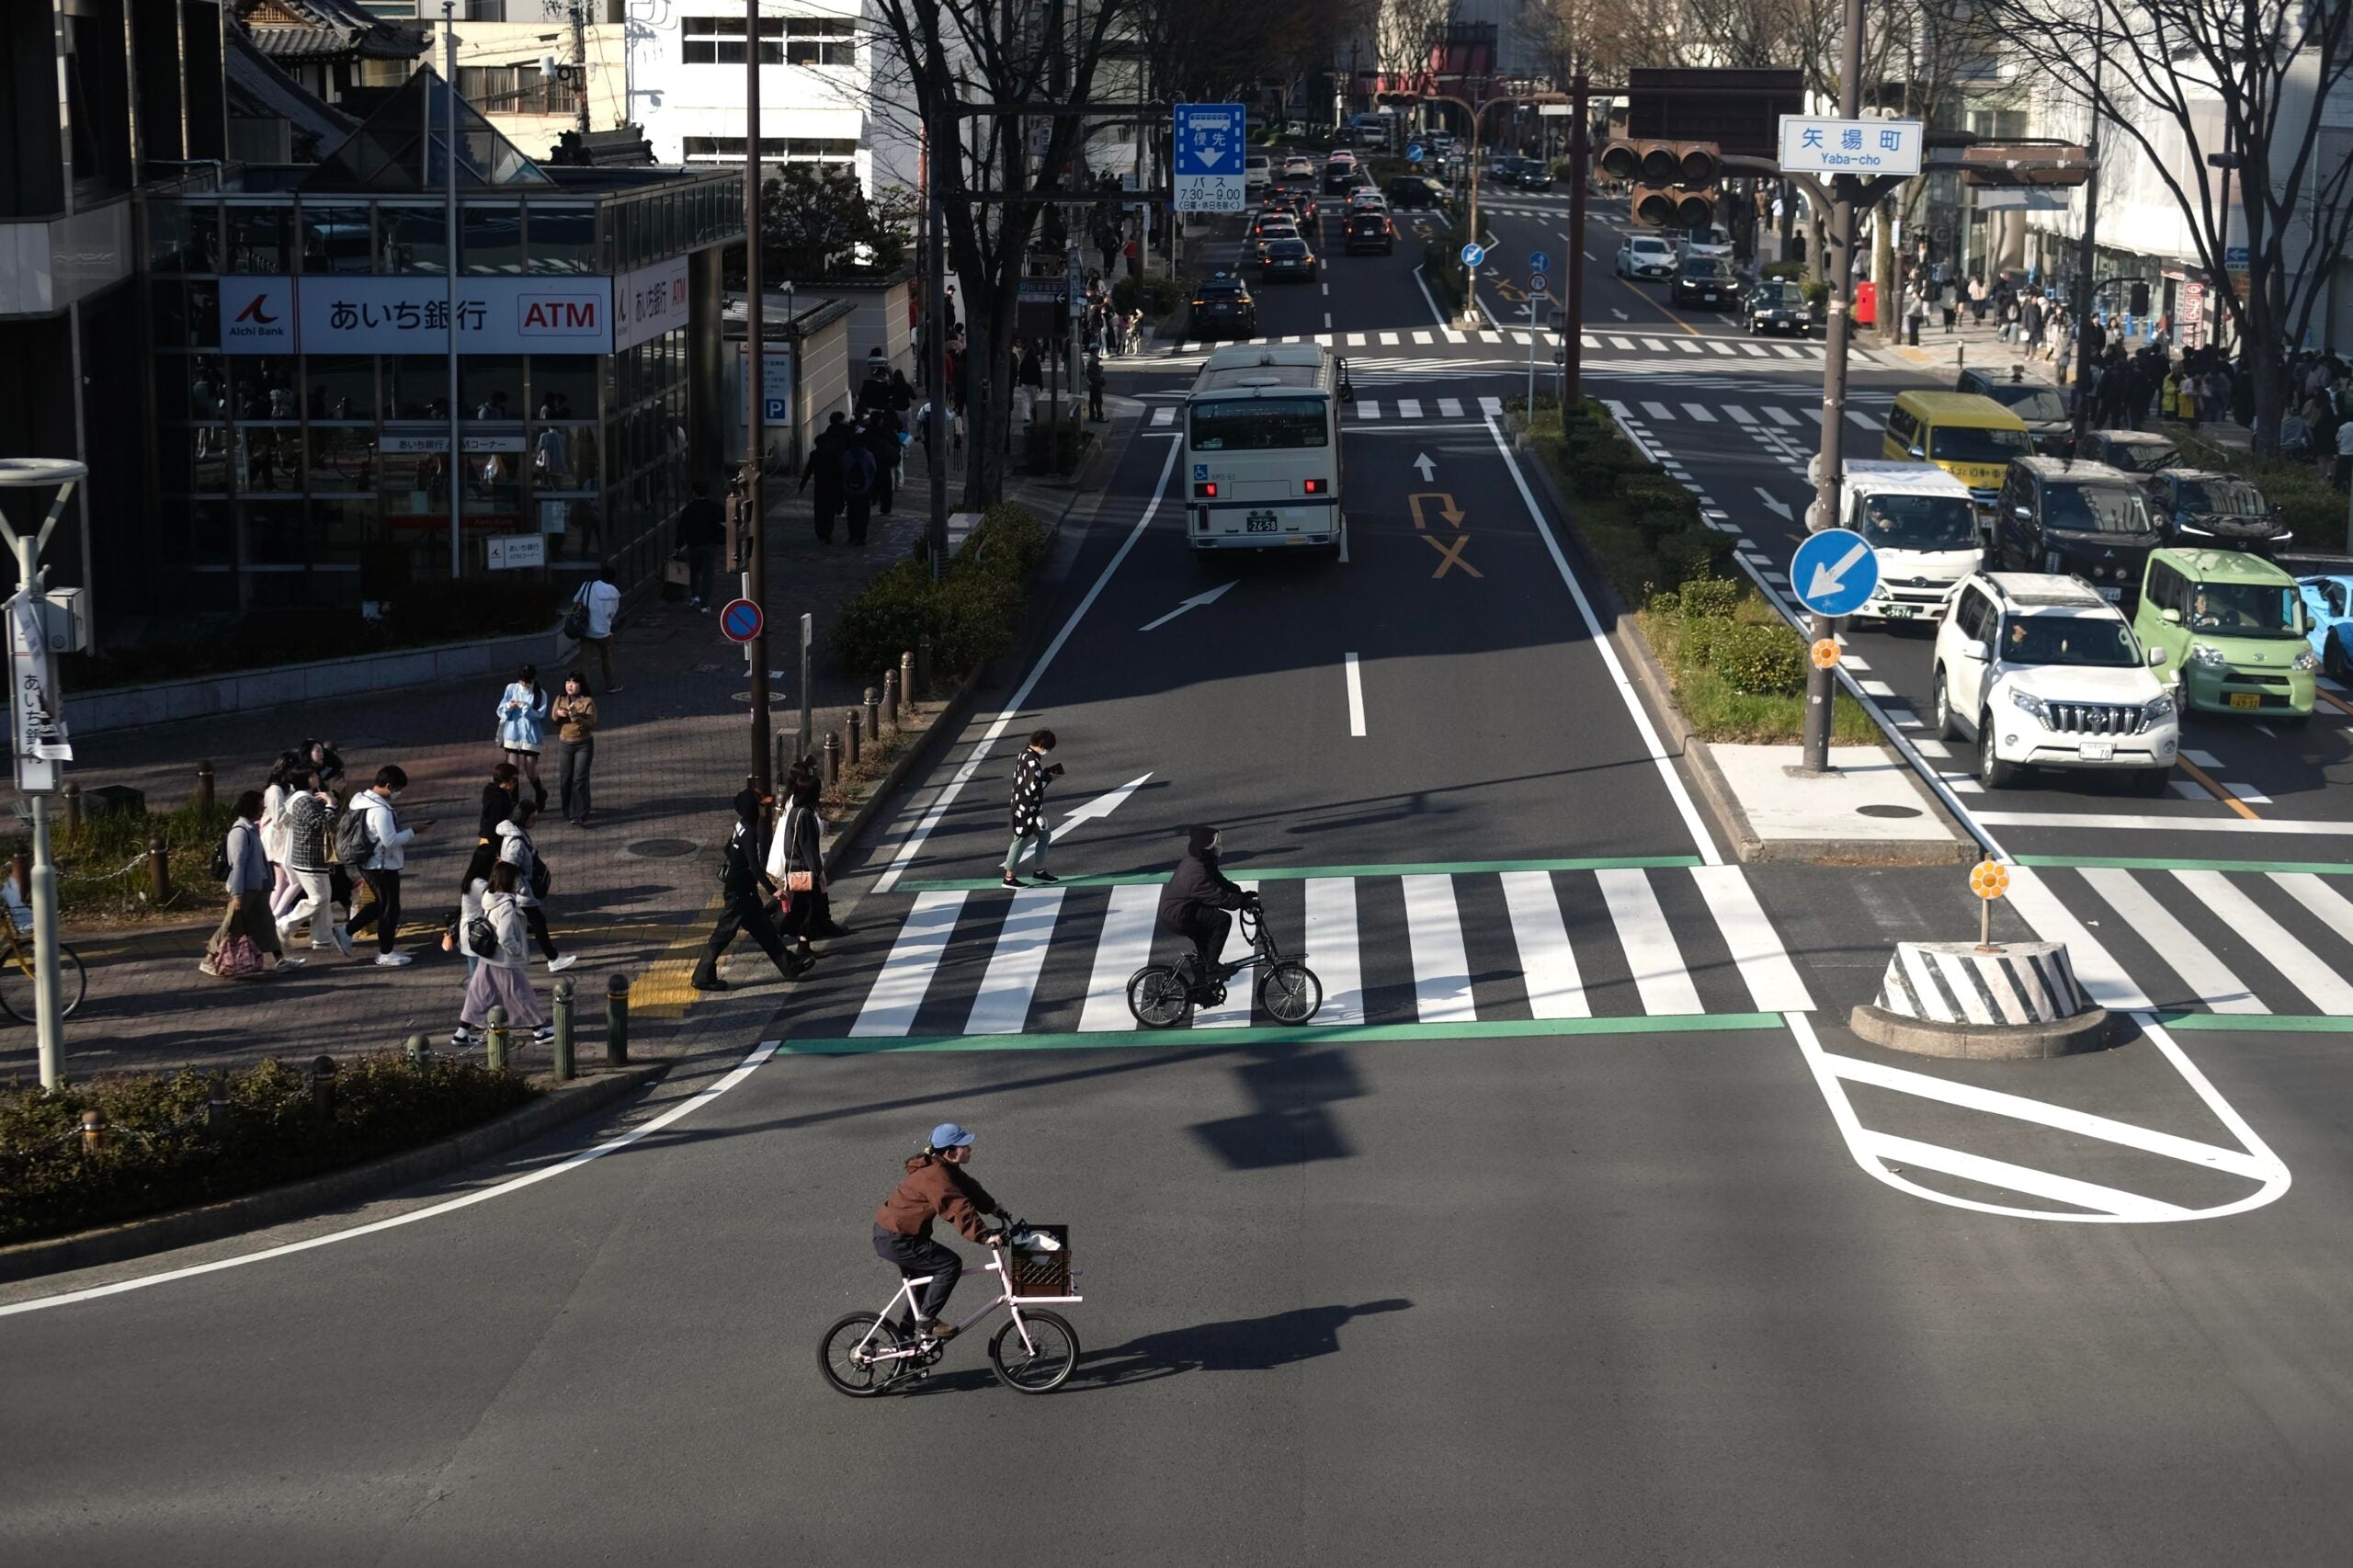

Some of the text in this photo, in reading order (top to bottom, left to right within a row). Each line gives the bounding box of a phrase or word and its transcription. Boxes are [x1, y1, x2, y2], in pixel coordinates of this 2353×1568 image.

[1194, 131, 1226, 146] 優先
[1802, 128, 1901, 151] 矢場町
[1821, 153, 1881, 165] Yaba-cho
[1194, 177, 1225, 187] バス
[635, 281, 667, 323] あいち銀行
[672, 278, 687, 308] ATM
[330, 301, 487, 330] あいち銀行
[524, 303, 595, 327] ATM
[230, 326, 284, 335] Aichi Bank
